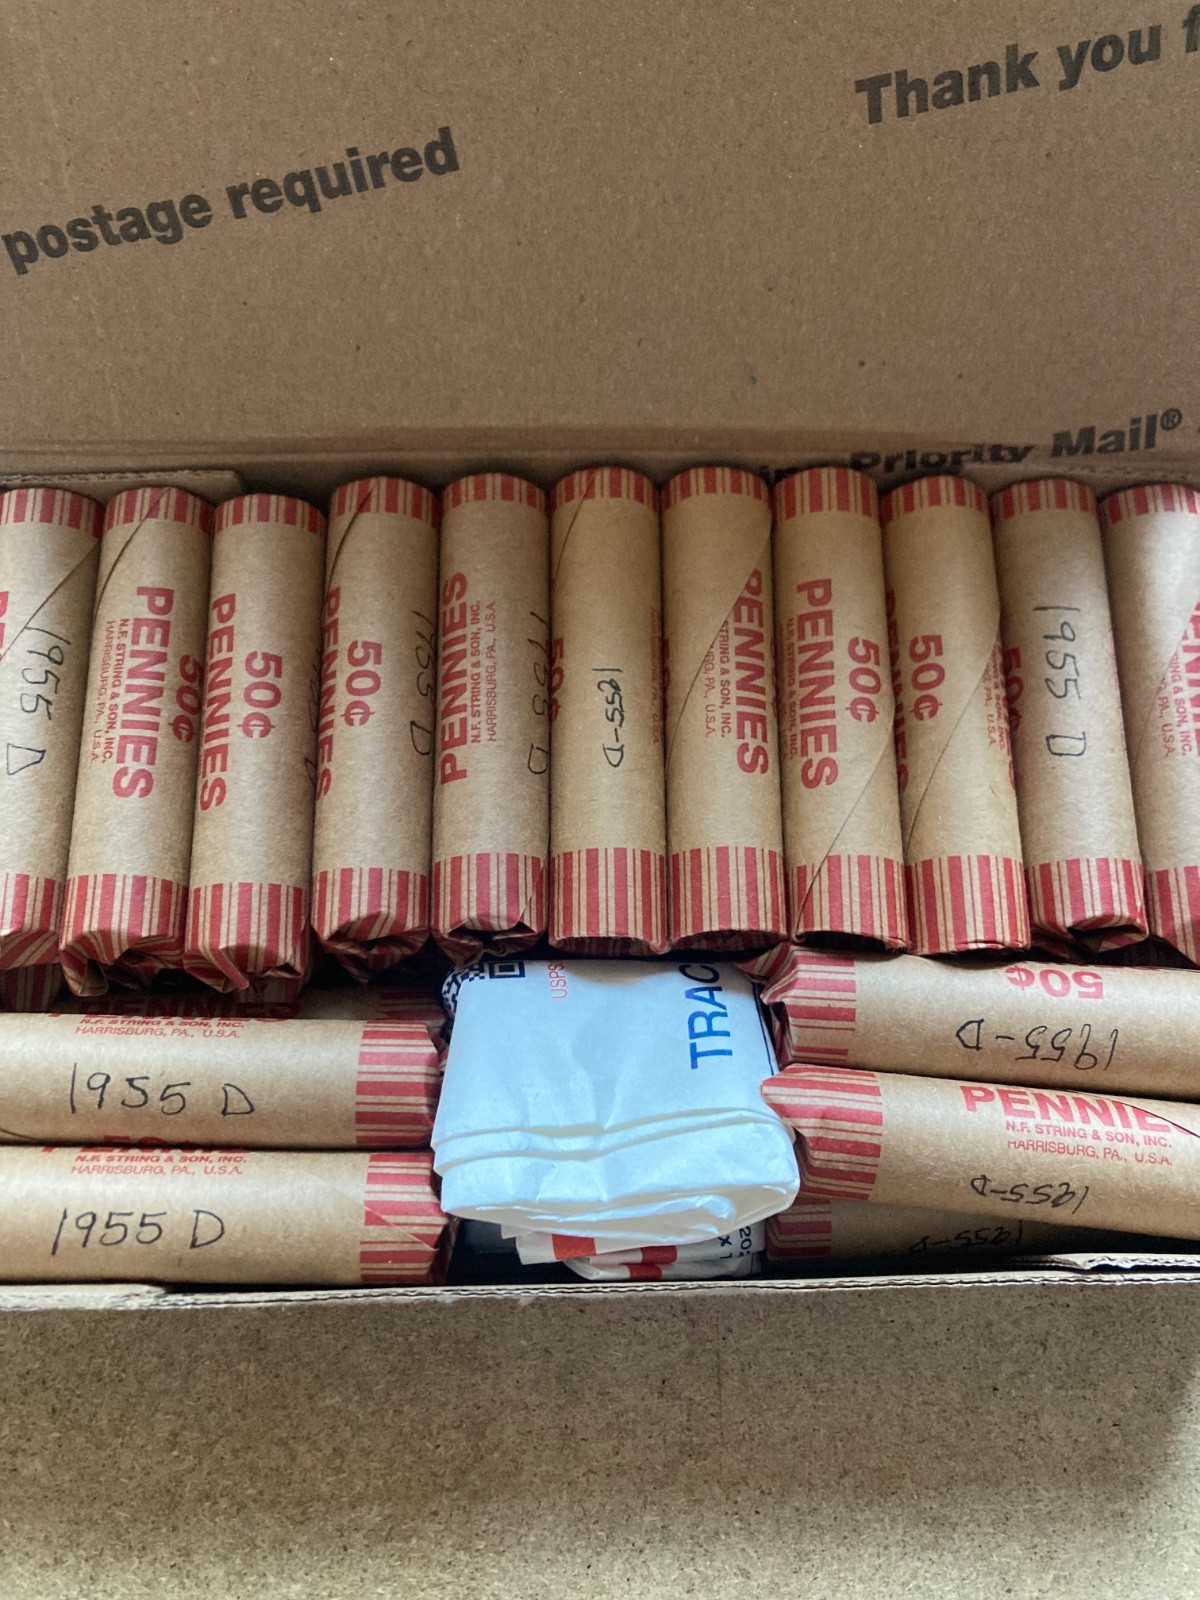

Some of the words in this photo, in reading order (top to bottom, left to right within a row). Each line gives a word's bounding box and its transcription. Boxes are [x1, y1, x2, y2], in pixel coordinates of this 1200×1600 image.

[854, 43, 1040, 125] Thank
[1056, 24, 1162, 91] you
[1, 192, 213, 275] postage
[225, 126, 460, 219] required
[471, 600, 482, 625] INC.
[471, 628, 482, 657] SON,
[1033, 605, 1082, 700] 1955
[20, 626, 72, 721] 1955
[111, 643, 126, 688] STRING
[340, 639, 382, 727] 50¢
[440, 571, 468, 786] PENNIES
[471, 660, 482, 669] &
[719, 667, 730, 676] &
[732, 568, 770, 775] PENNIES
[797, 578, 838, 789] PENNIES
[845, 636, 882, 724] 50¢
[908, 634, 945, 722] 50¢
[112, 586, 174, 799] PENNIES
[200, 593, 236, 811] PENNIES
[237, 650, 284, 740] 50¢
[316, 586, 341, 801] PENNIES
[471, 672, 482, 718] STRING
[485, 662, 497, 742] HARRISBURG,
[719, 680, 731, 710] SON,
[103, 703, 119, 734] SON,
[720, 712, 732, 739] INC.
[1174, 698, 1189, 728] SON,
[6, 743, 47, 776] D
[101, 737, 117, 764] INC.
[1046, 731, 1087, 756] D
[1179, 730, 1192, 757] INC.
[1004, 964, 1104, 1000] 50¢
[74, 1026, 167, 1038] HARRISBURG,
[108, 1019, 162, 1027] STRING
[178, 1021, 212, 1029] SON,
[216, 1021, 246, 1029] INC.
[70, 1062, 192, 1116] 1955
[221, 1083, 255, 1117] D
[1006, 1120, 1031, 1133] N.F.
[1035, 1124, 1088, 1139] STRING
[1091, 1131, 1102, 1141] &
[1105, 1132, 1140, 1147] SON,
[1143, 1136, 1173, 1149] INC.
[1007, 1140, 1100, 1160] HARRISBURG,
[1134, 1151, 1173, 1166] U.S.A.
[70, 1164, 167, 1176] HARRISBURG,
[105, 1154, 161, 1163] STRING
[178, 1155, 214, 1164] SON,
[217, 1155, 248, 1163] INC.
[51, 1208, 167, 1256] 1955
[189, 1208, 225, 1250] D
